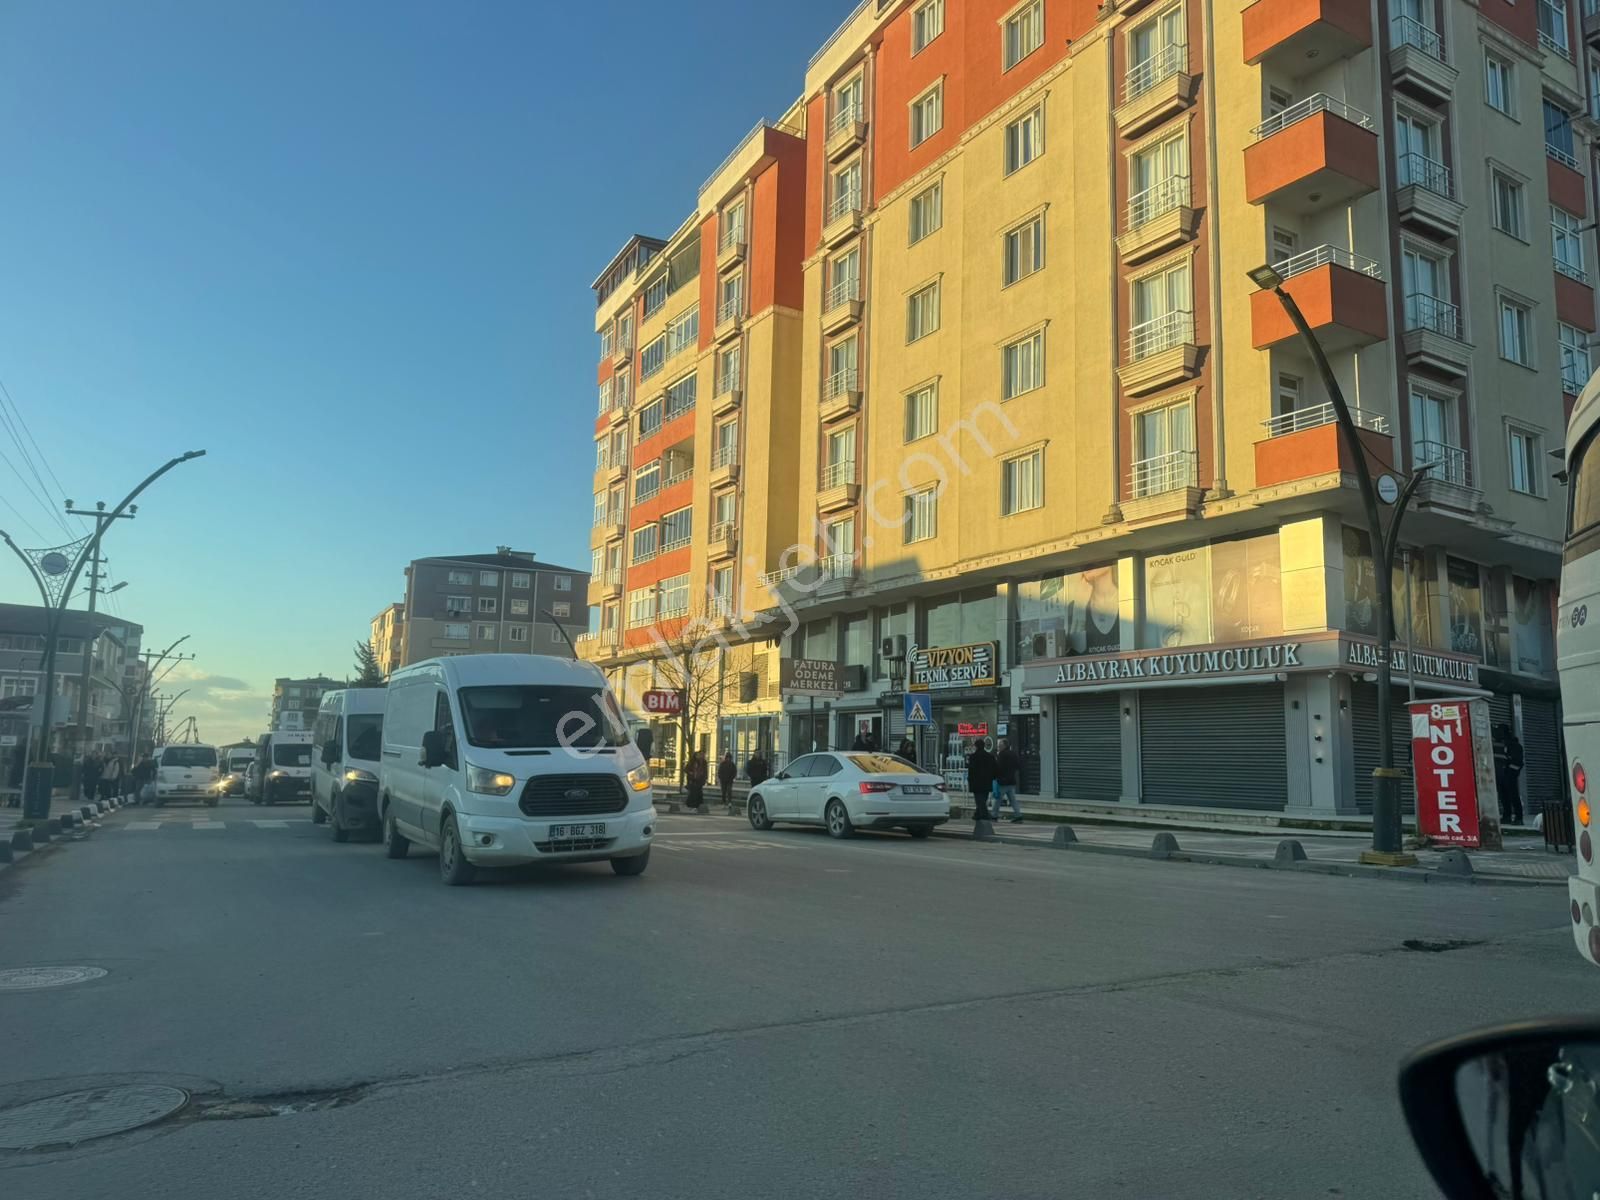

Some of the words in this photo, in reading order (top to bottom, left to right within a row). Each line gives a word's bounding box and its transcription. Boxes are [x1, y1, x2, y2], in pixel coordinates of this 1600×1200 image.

[793, 660, 835, 671] FATURA
[1055, 657, 1147, 683] ALBAYRAK
[1150, 643, 1300, 676] KUYUMCULUK
[1349, 642, 1406, 671] ALBAAK
[914, 666, 949, 684] TEKNİK
[950, 662, 989, 681] SERVİS
[1430, 724, 1463, 833] NOTER
